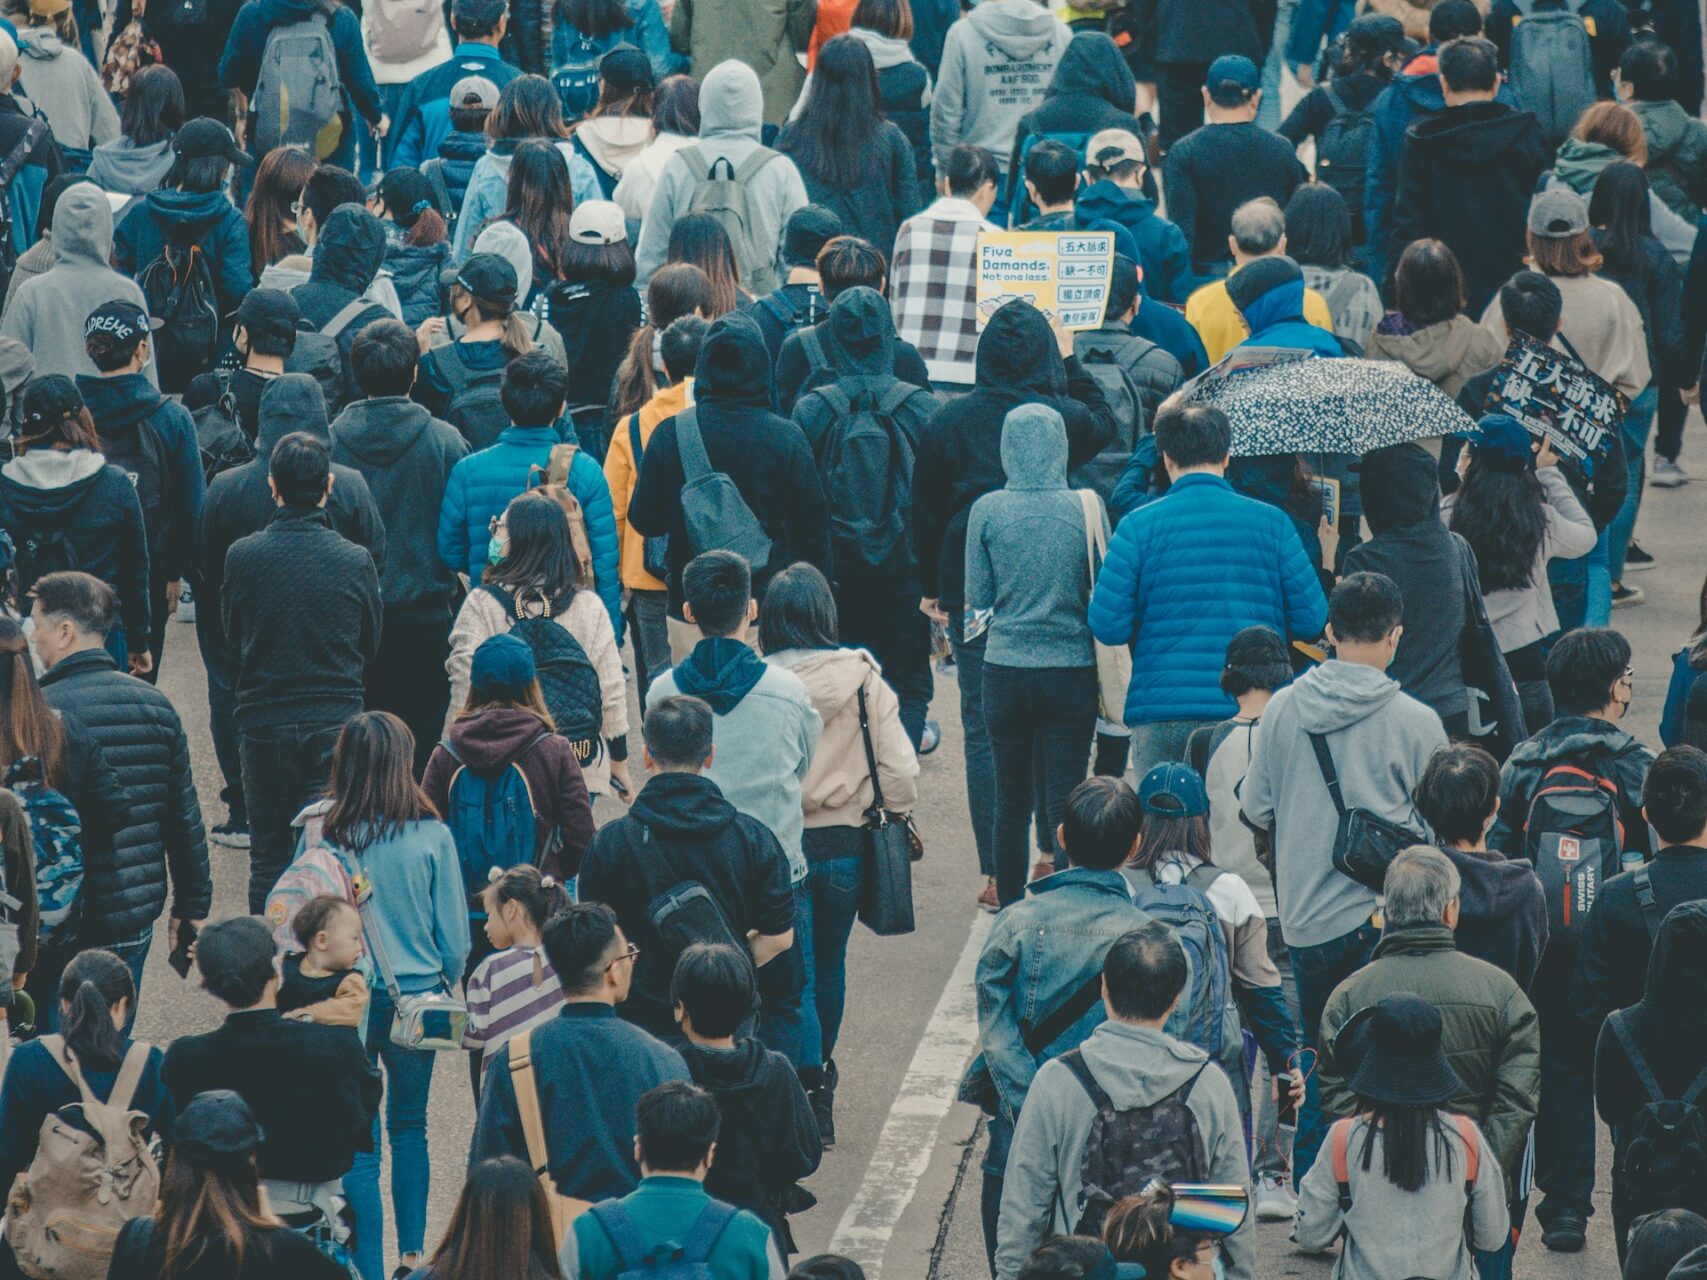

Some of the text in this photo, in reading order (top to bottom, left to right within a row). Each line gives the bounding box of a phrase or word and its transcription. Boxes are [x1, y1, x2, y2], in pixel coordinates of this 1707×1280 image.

[982, 246, 1013, 257] Five
[1065, 241, 1106, 253] 五大訴求
[1065, 265, 1106, 276] 缺一不可
[982, 273, 1001, 281] Not
[1512, 345, 1618, 425] 五大訴求
[1501, 372, 1610, 451] 缺一不可
[1577, 873, 1586, 912] SWISS
